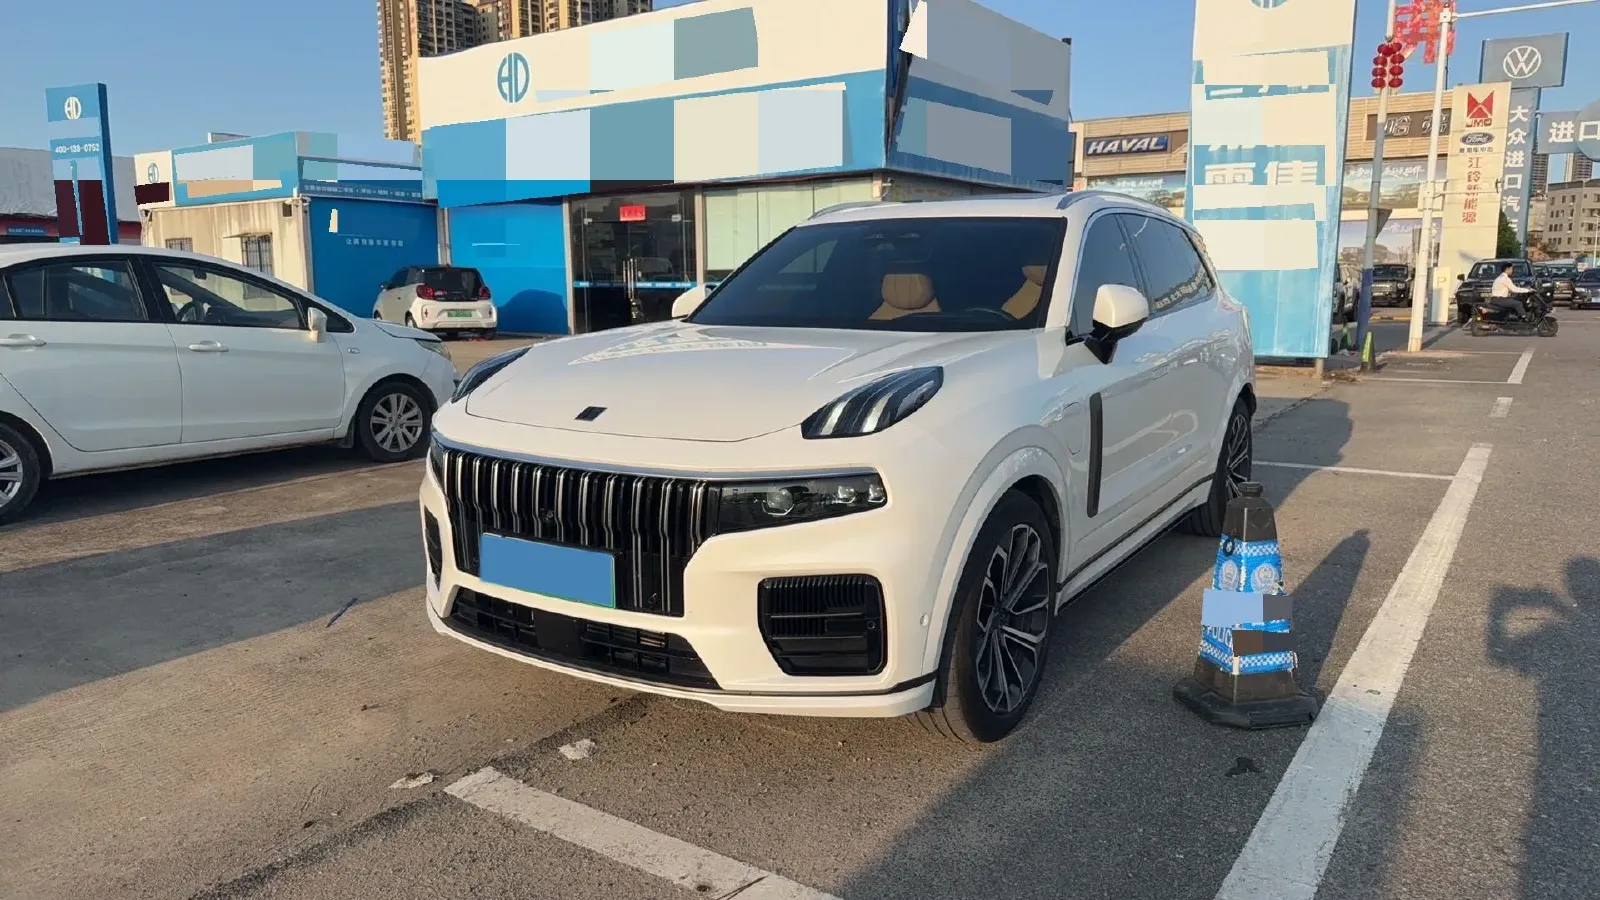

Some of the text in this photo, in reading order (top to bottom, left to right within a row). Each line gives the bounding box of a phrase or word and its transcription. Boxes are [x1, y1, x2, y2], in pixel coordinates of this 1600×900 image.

[1465, 132, 1489, 144] Ford
[1548, 120, 1600, 143] 进口
[1087, 136, 1167, 154] HAVAL
